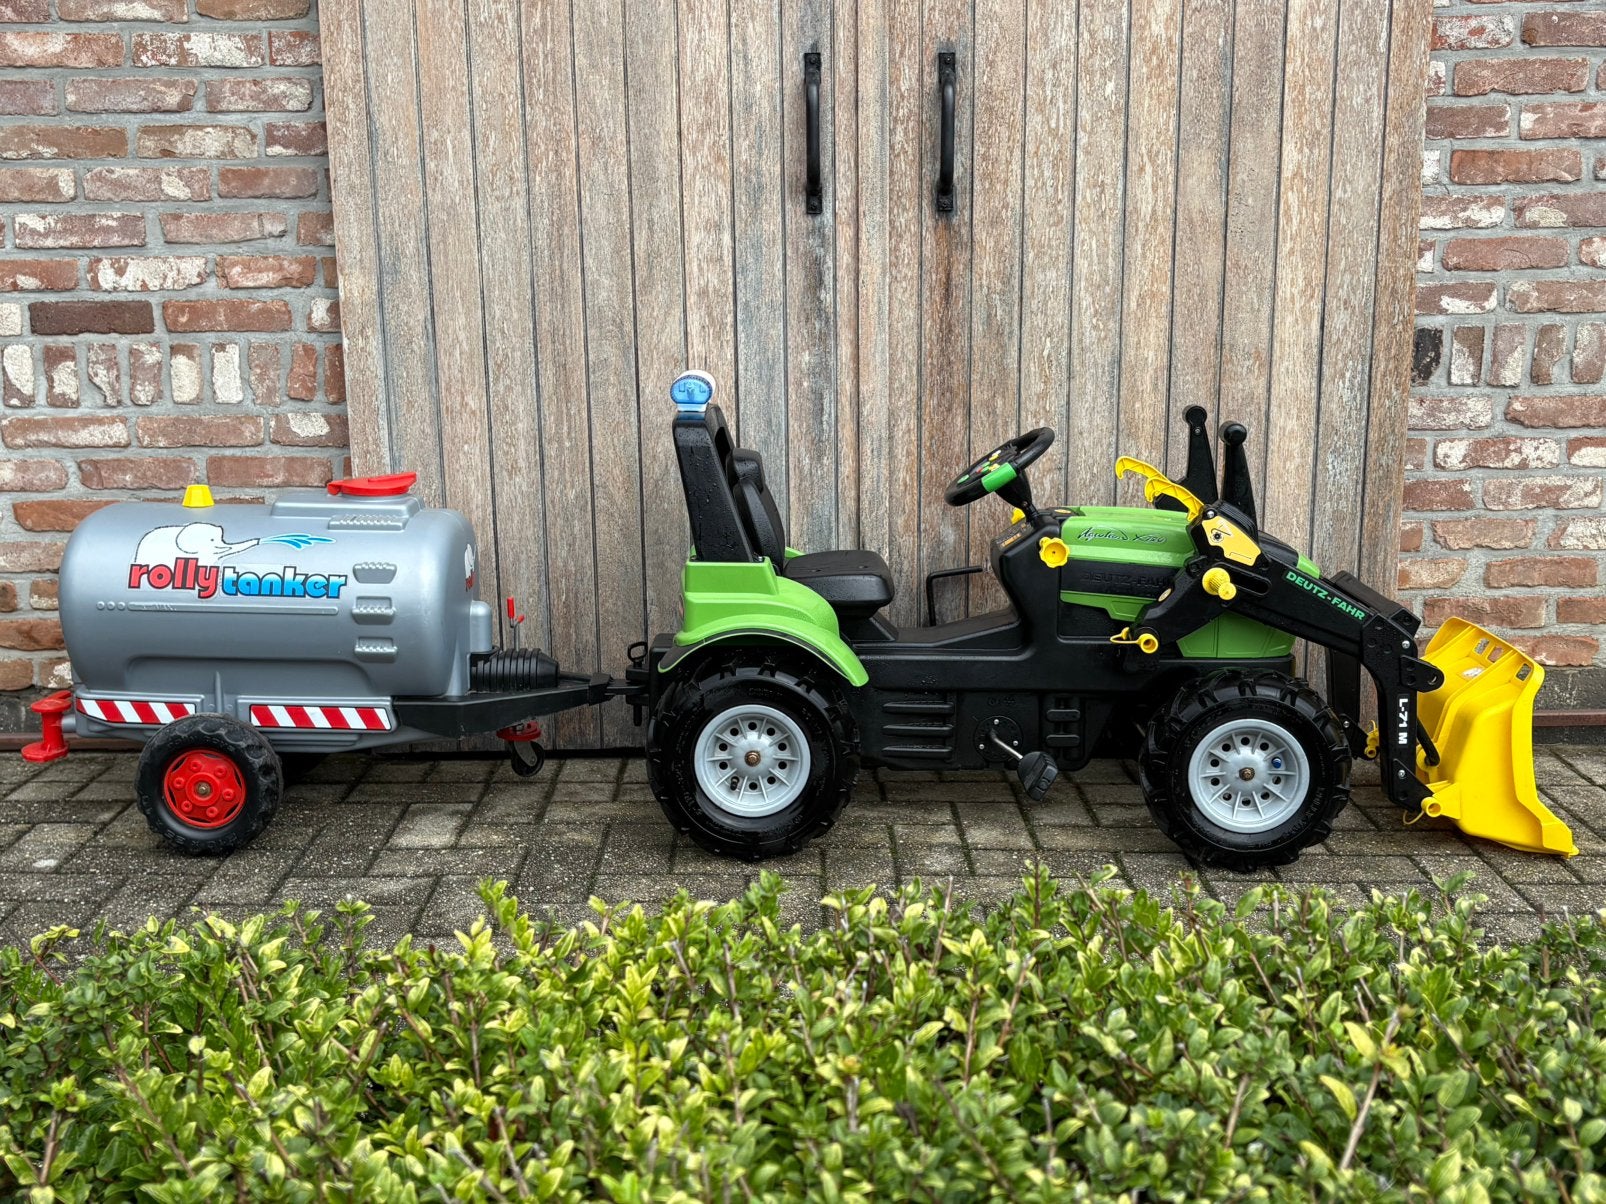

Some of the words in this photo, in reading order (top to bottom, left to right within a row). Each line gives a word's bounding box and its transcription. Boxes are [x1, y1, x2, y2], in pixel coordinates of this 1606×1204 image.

[128, 557, 220, 599] rolly
[221, 565, 348, 599] tanker
[1286, 571, 1366, 621] DEUTZ-FAHR
[1399, 698, 1408, 728] L-71
[1398, 731, 1408, 745] M
